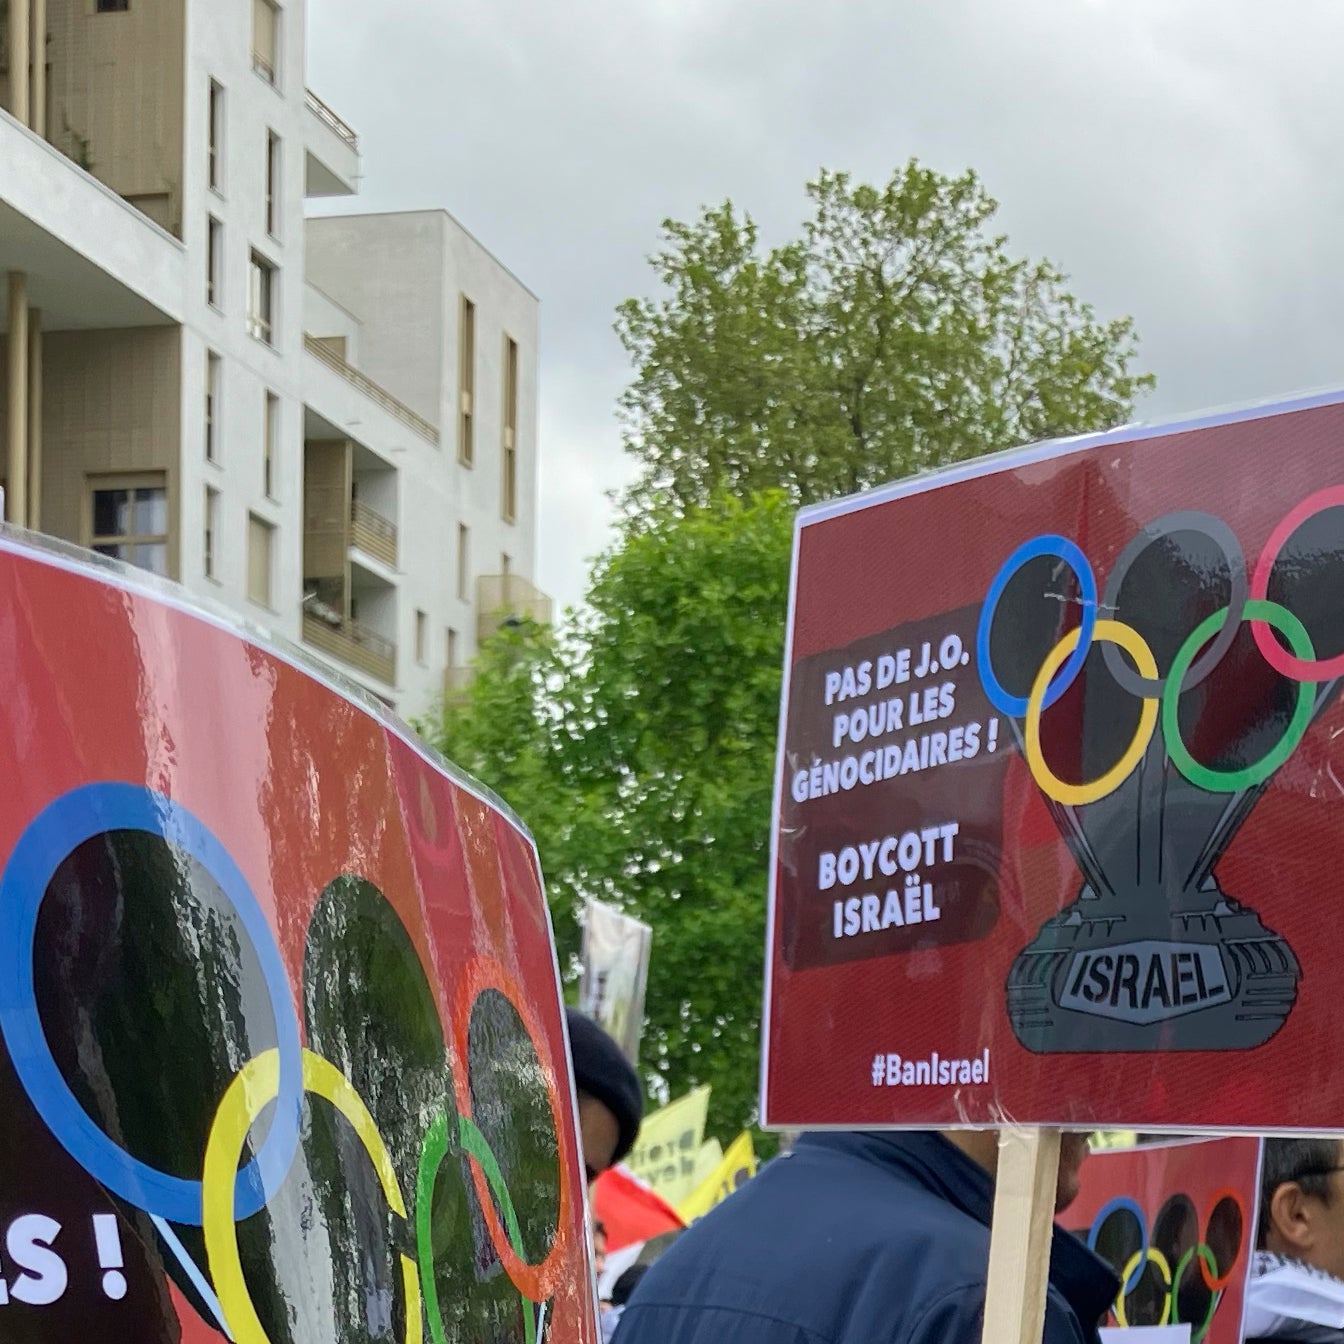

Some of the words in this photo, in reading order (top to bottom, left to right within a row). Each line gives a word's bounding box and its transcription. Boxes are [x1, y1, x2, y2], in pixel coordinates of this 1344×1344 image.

[824, 660, 872, 705] PAS
[876, 648, 910, 690] DE
[914, 634, 969, 678] J.O.
[832, 698, 904, 748] POUR
[909, 681, 956, 726] LES
[791, 722, 982, 803] GÉNOCIDAIRES
[987, 717, 999, 752] !
[818, 822, 959, 890] BOYCOTT
[833, 873, 940, 938] ISRAËL
[1070, 953, 1224, 1008] ISRAEL
[871, 1047, 989, 1086] #BanIsrael
[93, 1213, 128, 1300] !
